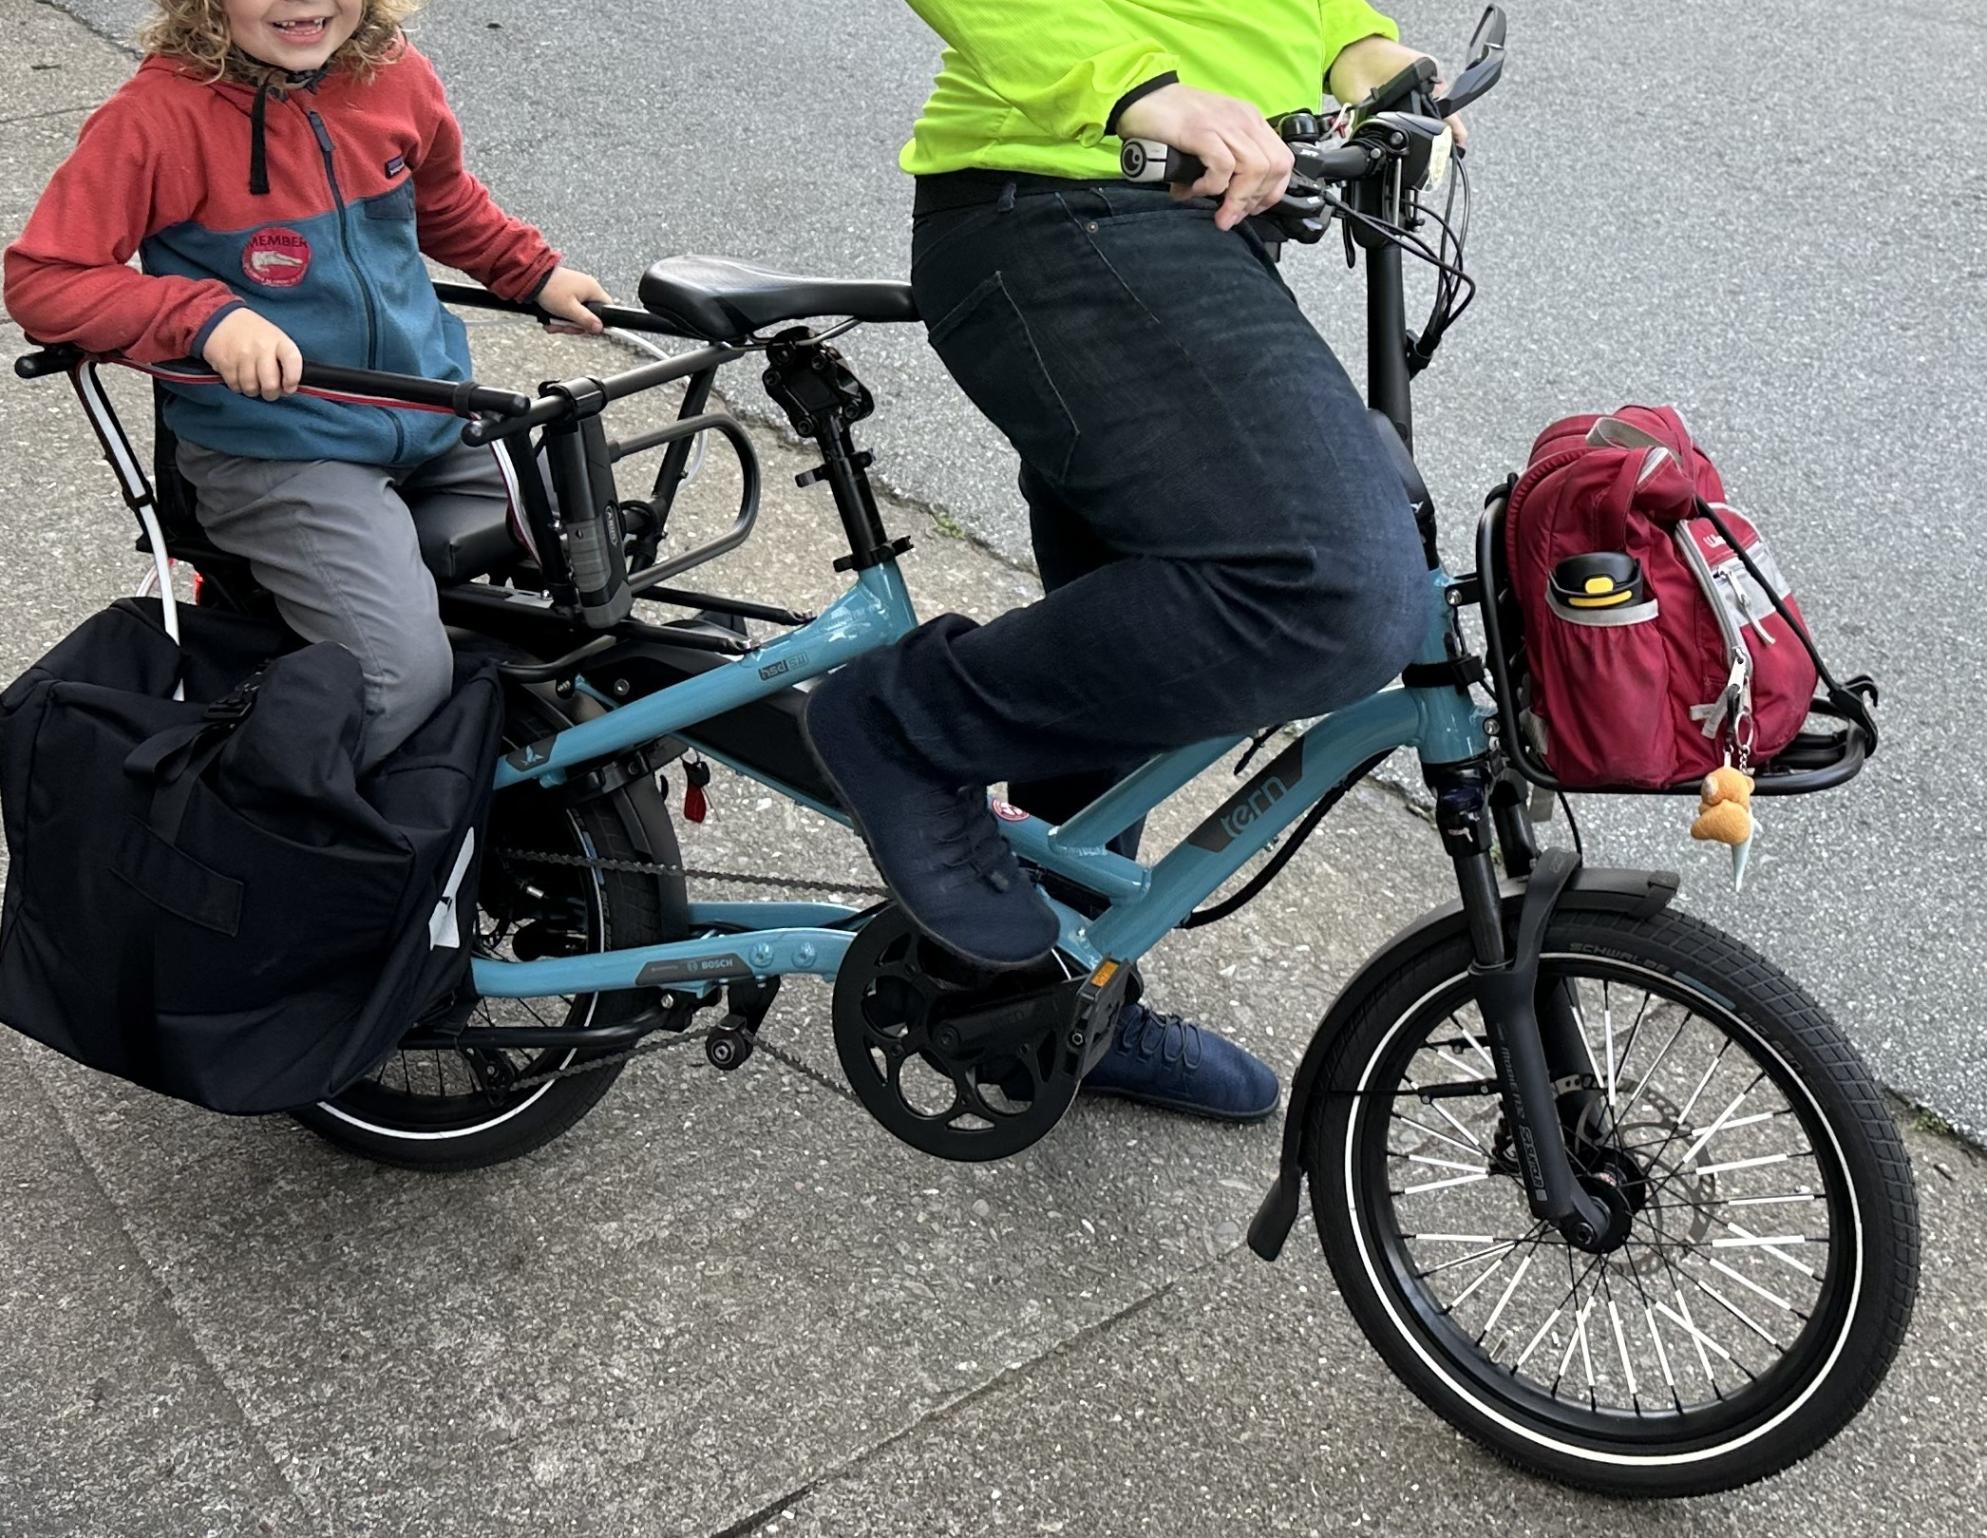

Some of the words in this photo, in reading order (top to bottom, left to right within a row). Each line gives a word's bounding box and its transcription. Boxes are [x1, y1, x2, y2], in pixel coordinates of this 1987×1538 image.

[245, 234, 308, 250] MEMBER
[1220, 776, 1288, 838] tern
[701, 959, 734, 970] BOSCH
[1569, 942, 1671, 973] SCHWALBE
